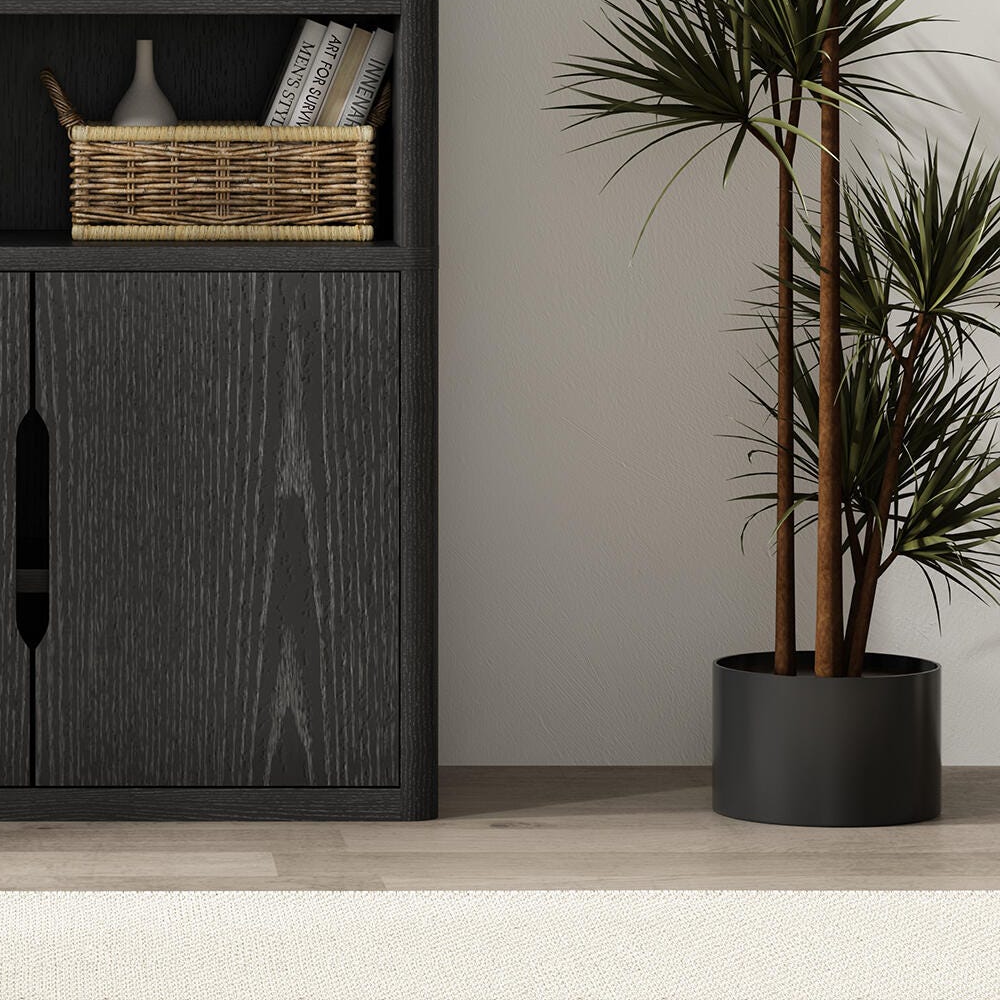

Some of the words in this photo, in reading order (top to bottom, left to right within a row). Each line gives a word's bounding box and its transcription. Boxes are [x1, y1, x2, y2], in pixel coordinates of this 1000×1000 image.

[324, 34, 342, 60] ART
[286, 40, 316, 89] MEN'S
[312, 60, 332, 86] FOR
